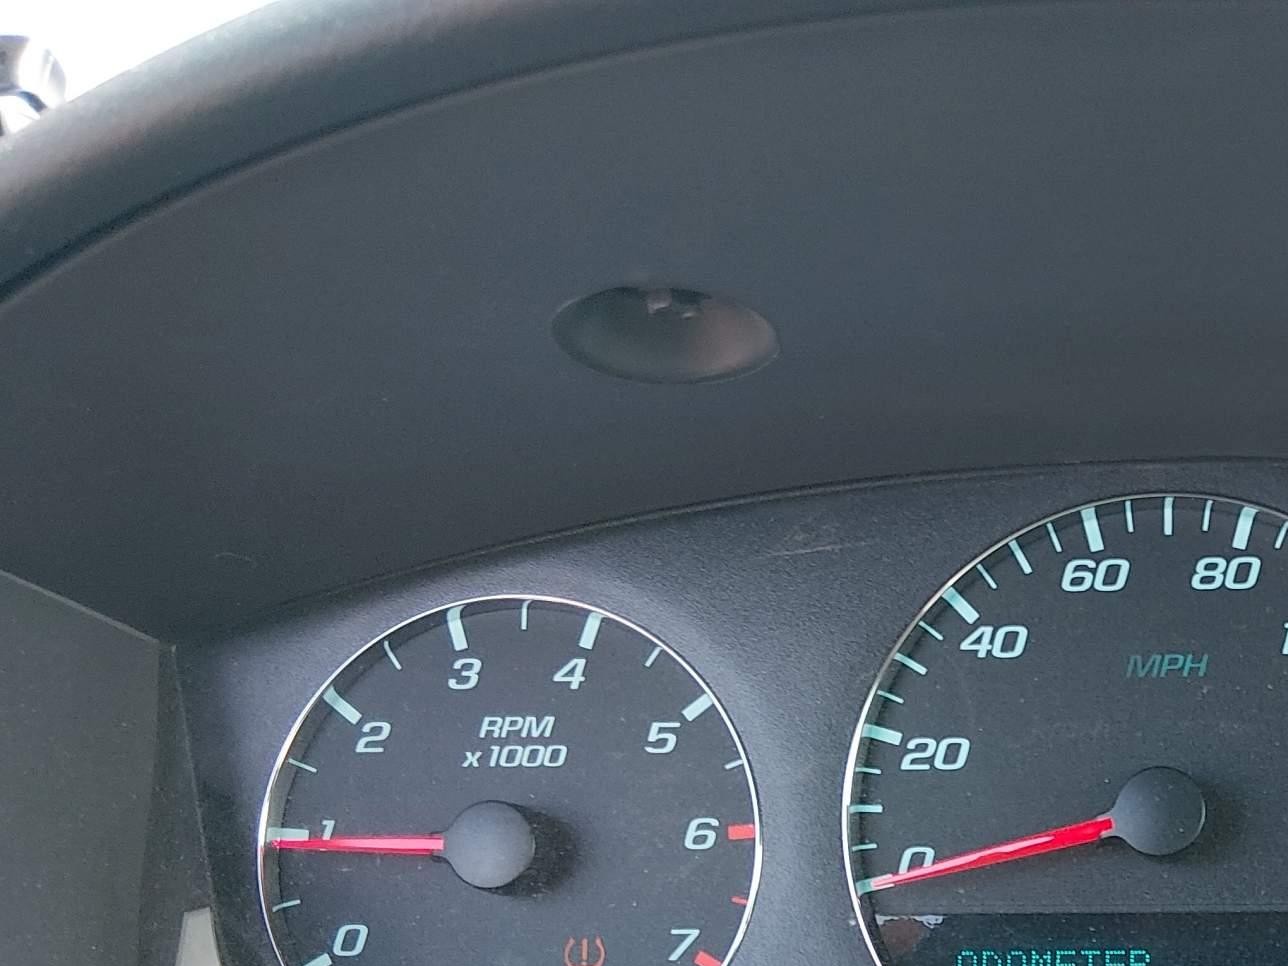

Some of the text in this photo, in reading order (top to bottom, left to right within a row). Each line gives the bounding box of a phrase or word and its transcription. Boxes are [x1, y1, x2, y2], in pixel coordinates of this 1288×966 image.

[1061, 558, 1131, 592] 60
[1190, 556, 1261, 590] 80
[959, 625, 1028, 658] 40
[447, 658, 482, 690] 3
[552, 658, 586, 690] 4
[1125, 654, 1209, 678] MPH
[355, 721, 392, 753] 2
[479, 716, 556, 738] RPM
[644, 722, 681, 754] 5
[900, 737, 971, 770] 20
[684, 817, 720, 851] 6
[332, 923, 370, 957] 0
[667, 928, 700, 961] 7
